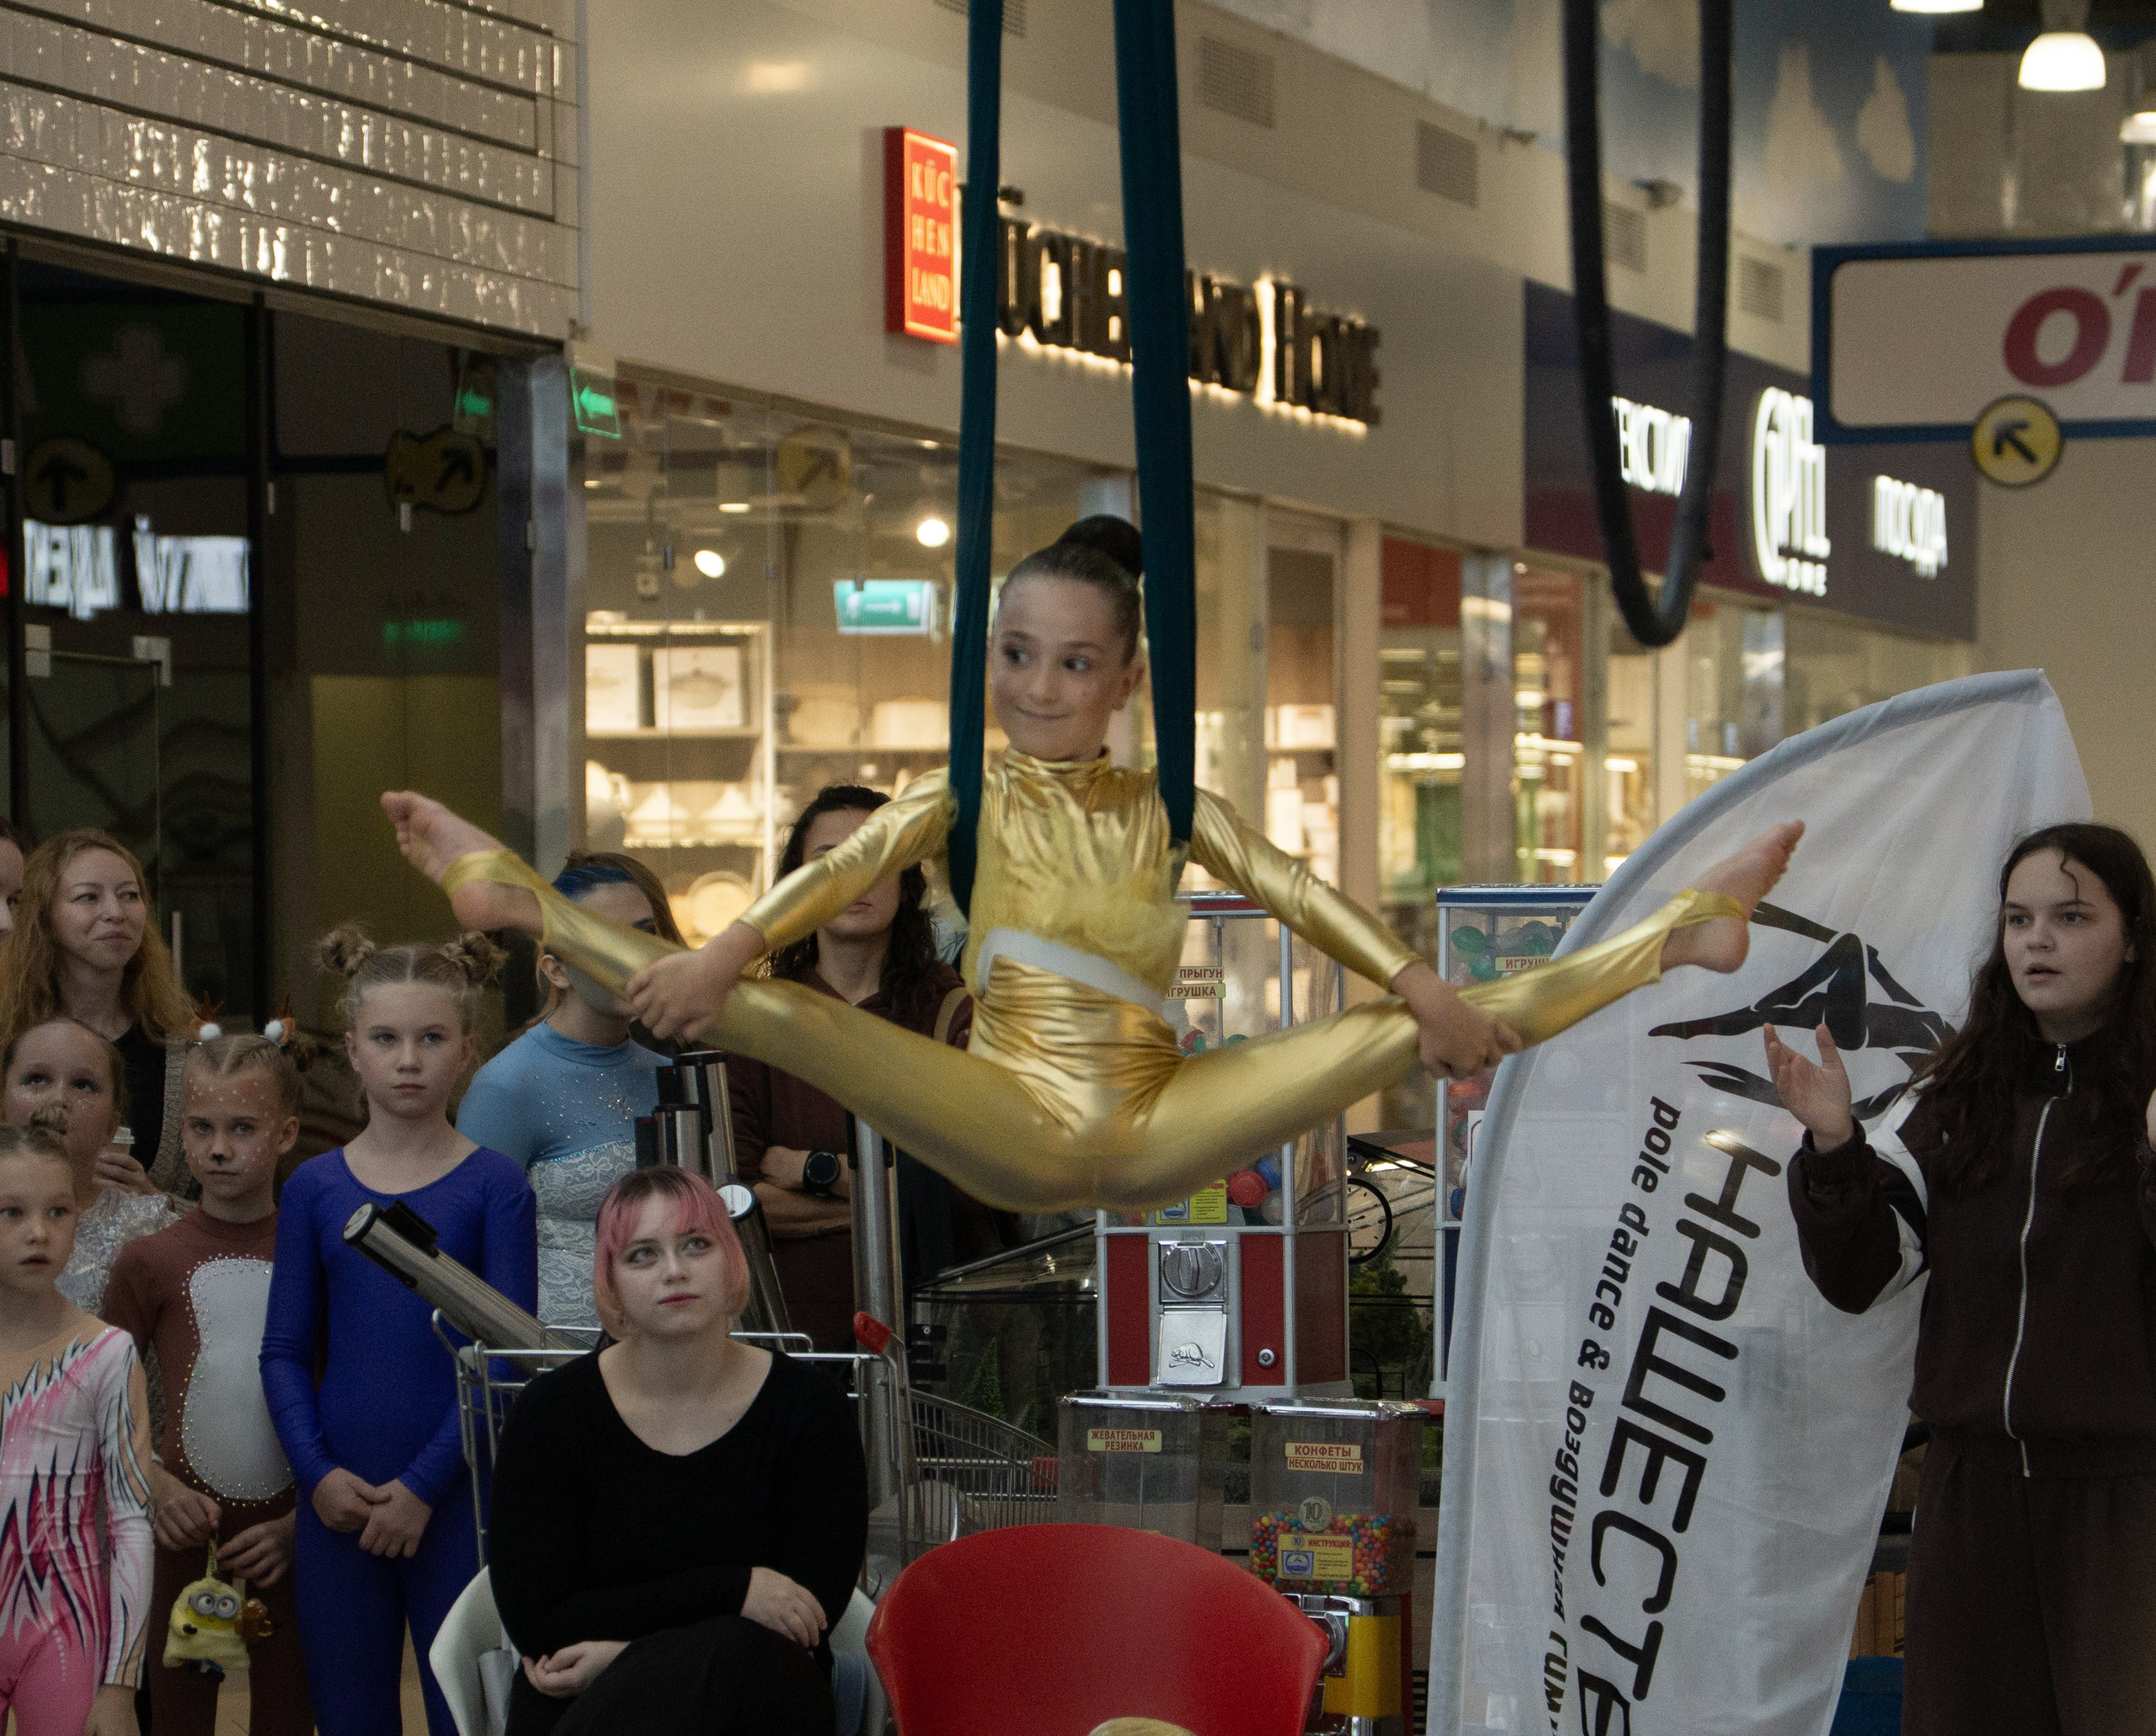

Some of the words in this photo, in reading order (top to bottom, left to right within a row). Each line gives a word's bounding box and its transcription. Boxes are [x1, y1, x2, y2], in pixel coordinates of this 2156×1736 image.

[911, 159, 949, 208] KÜC
[911, 214, 949, 258] HEN
[911, 267, 949, 312] LAND
[1180, 968, 1223, 979] ПРЫГУН
[1631, 1095, 1682, 1194] pole
[1588, 1202, 1651, 1331] dance
[1577, 1338, 1610, 1370] &
[1091, 1430, 1155, 1441] ЖЕВАТЕЛЬНАЯ
[1105, 1440, 1145, 1451] РЕЗИНКА
[1294, 1445, 1352, 1457] КОНФЕТЫ
[1289, 1458, 1337, 1471] НЕСКОЛЬКО
[1339, 1461, 1363, 1472] ШТУК
[1303, 1502, 1323, 1521] 10
